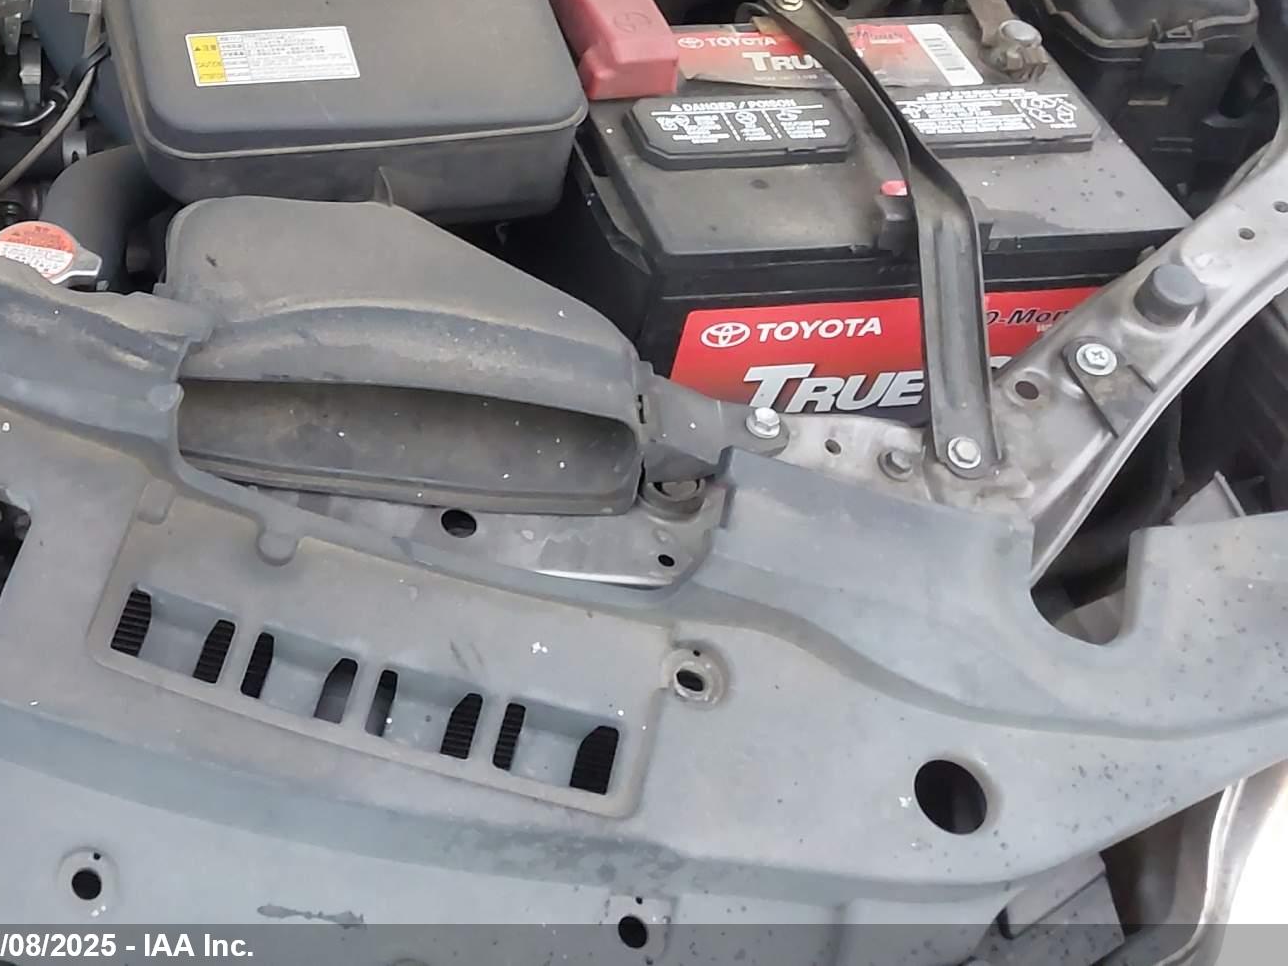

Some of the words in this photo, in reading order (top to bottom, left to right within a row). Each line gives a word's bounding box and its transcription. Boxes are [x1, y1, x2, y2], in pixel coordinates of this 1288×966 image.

[705, 36, 777, 47] TOYOTA
[682, 101, 737, 112] DANGER
[748, 98, 797, 109] POISON
[756, 316, 883, 343] TOYOTA
